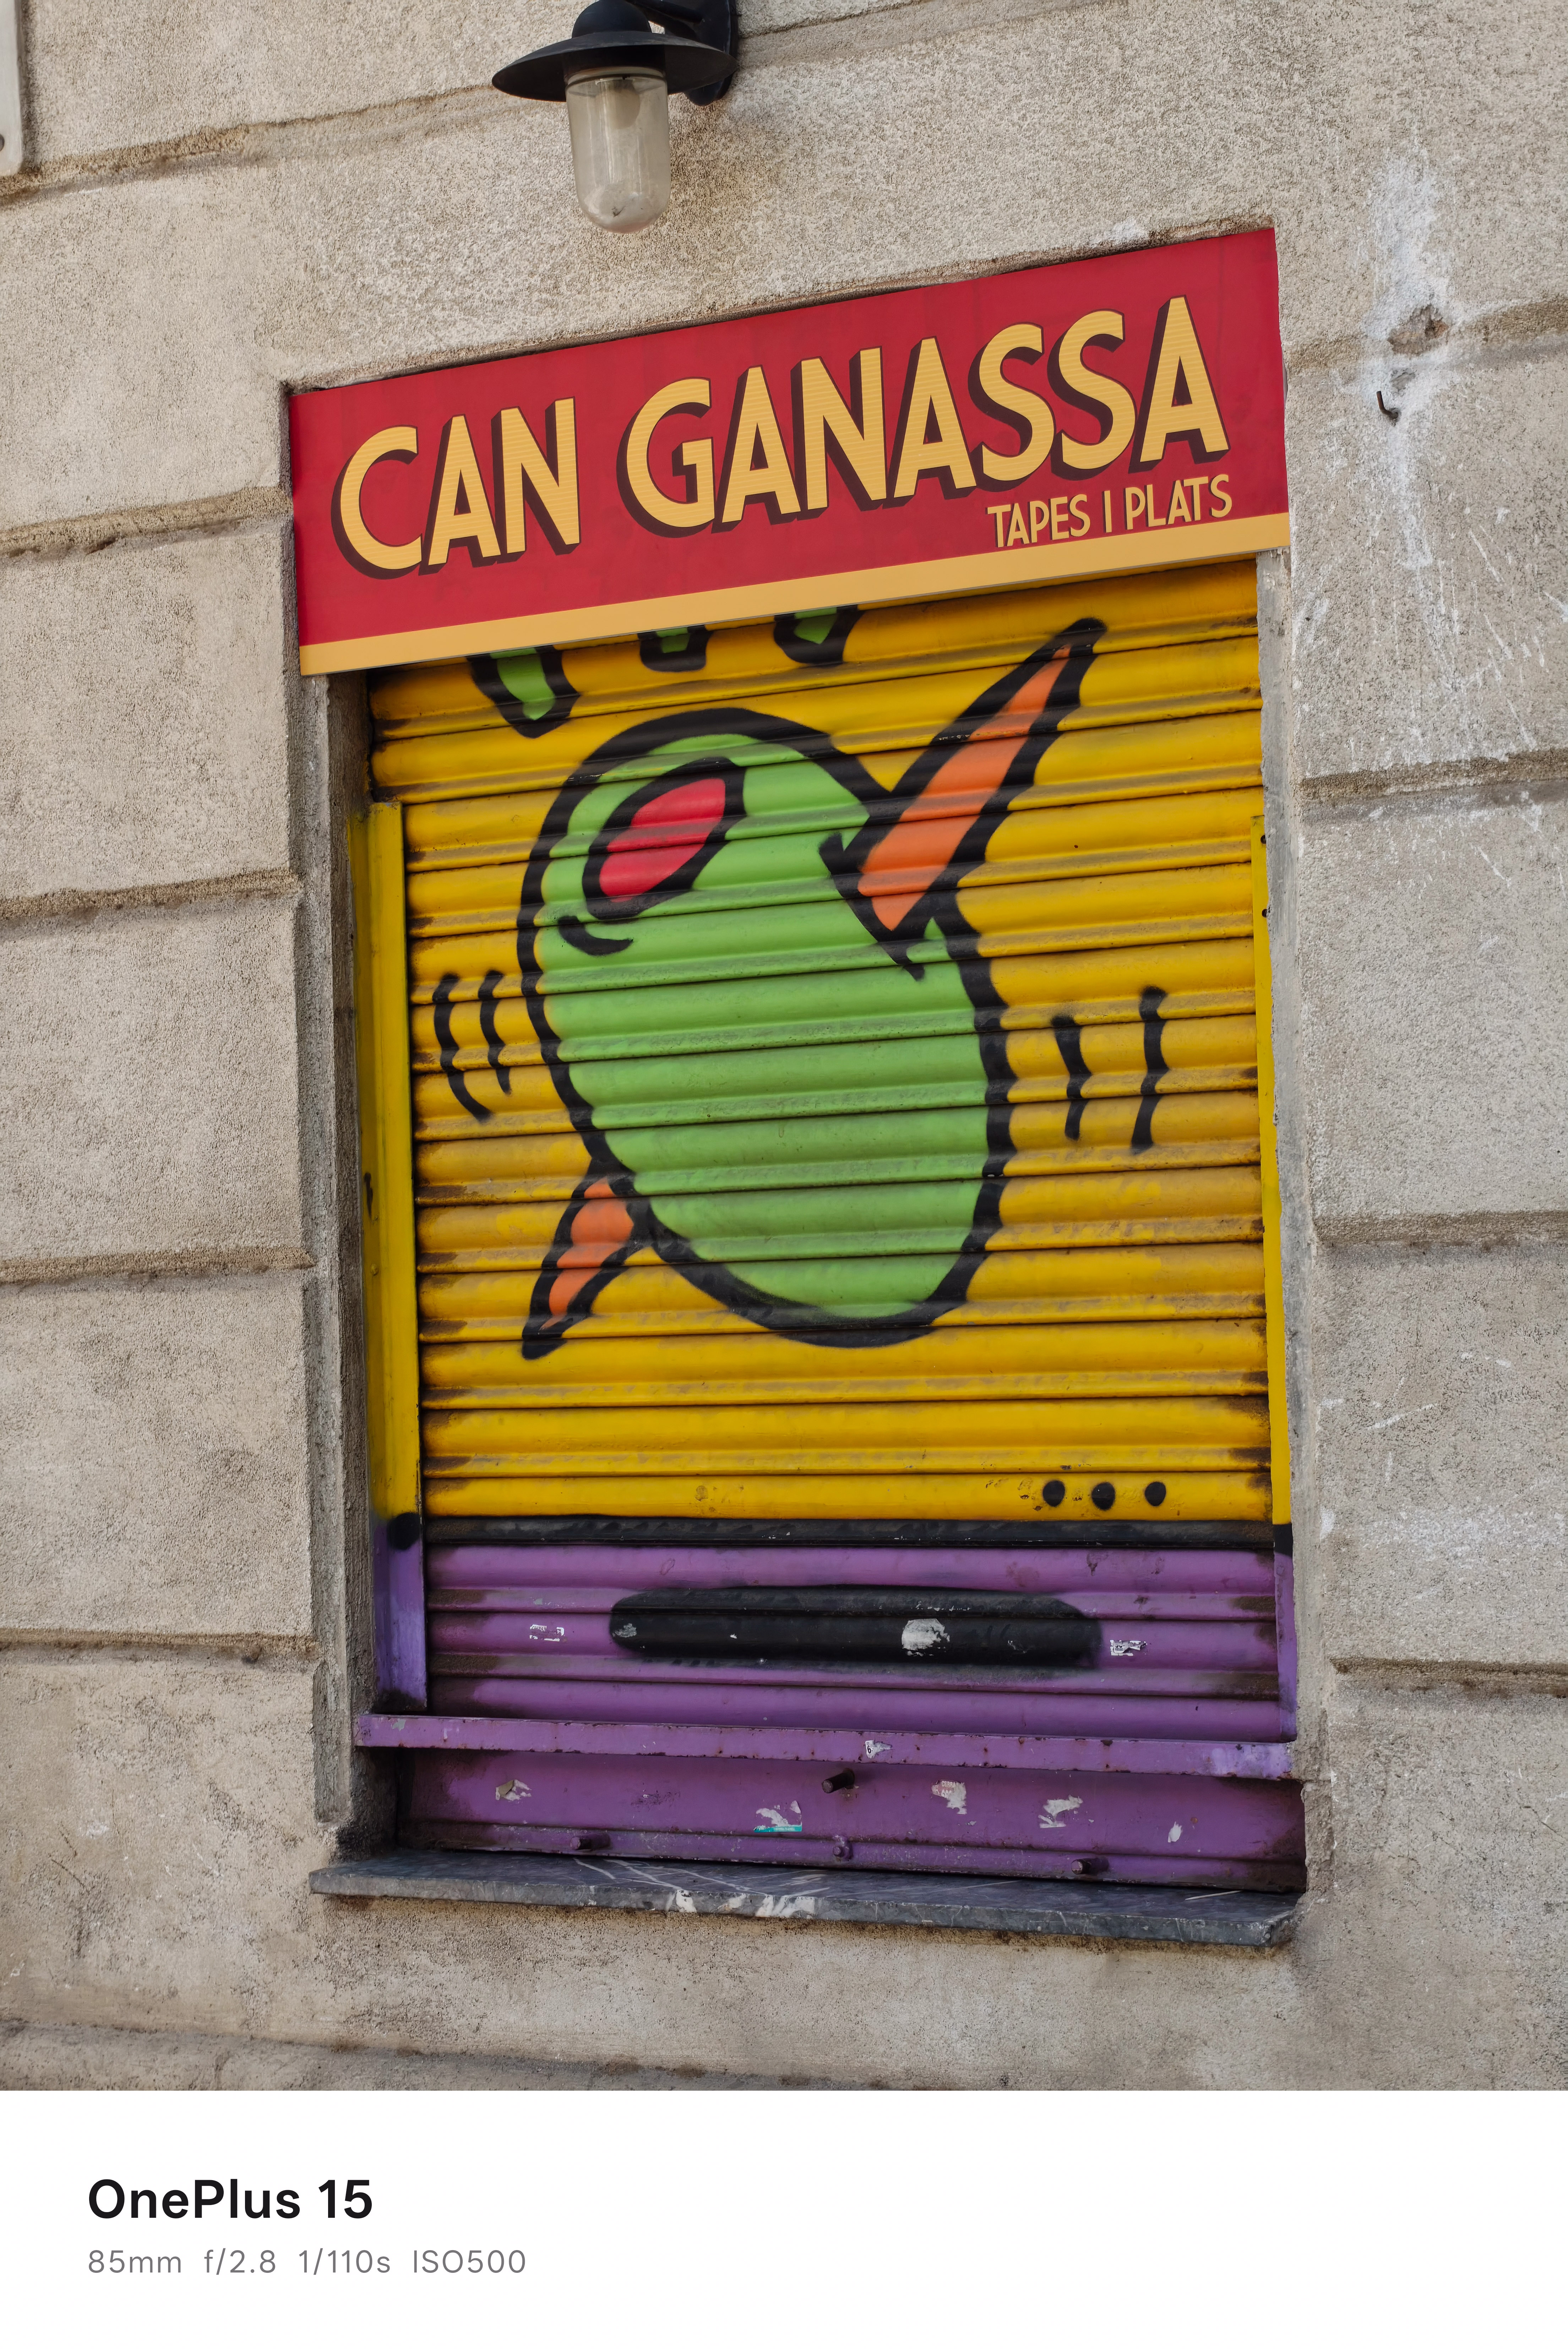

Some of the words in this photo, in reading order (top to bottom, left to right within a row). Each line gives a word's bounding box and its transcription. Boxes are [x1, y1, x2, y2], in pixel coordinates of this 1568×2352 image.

[338, 397, 580, 571] CAN
[624, 295, 1230, 530] GANASSA
[987, 494, 1090, 548] TAPES
[1103, 490, 1112, 533] I
[1125, 474, 1232, 530] PLATS
